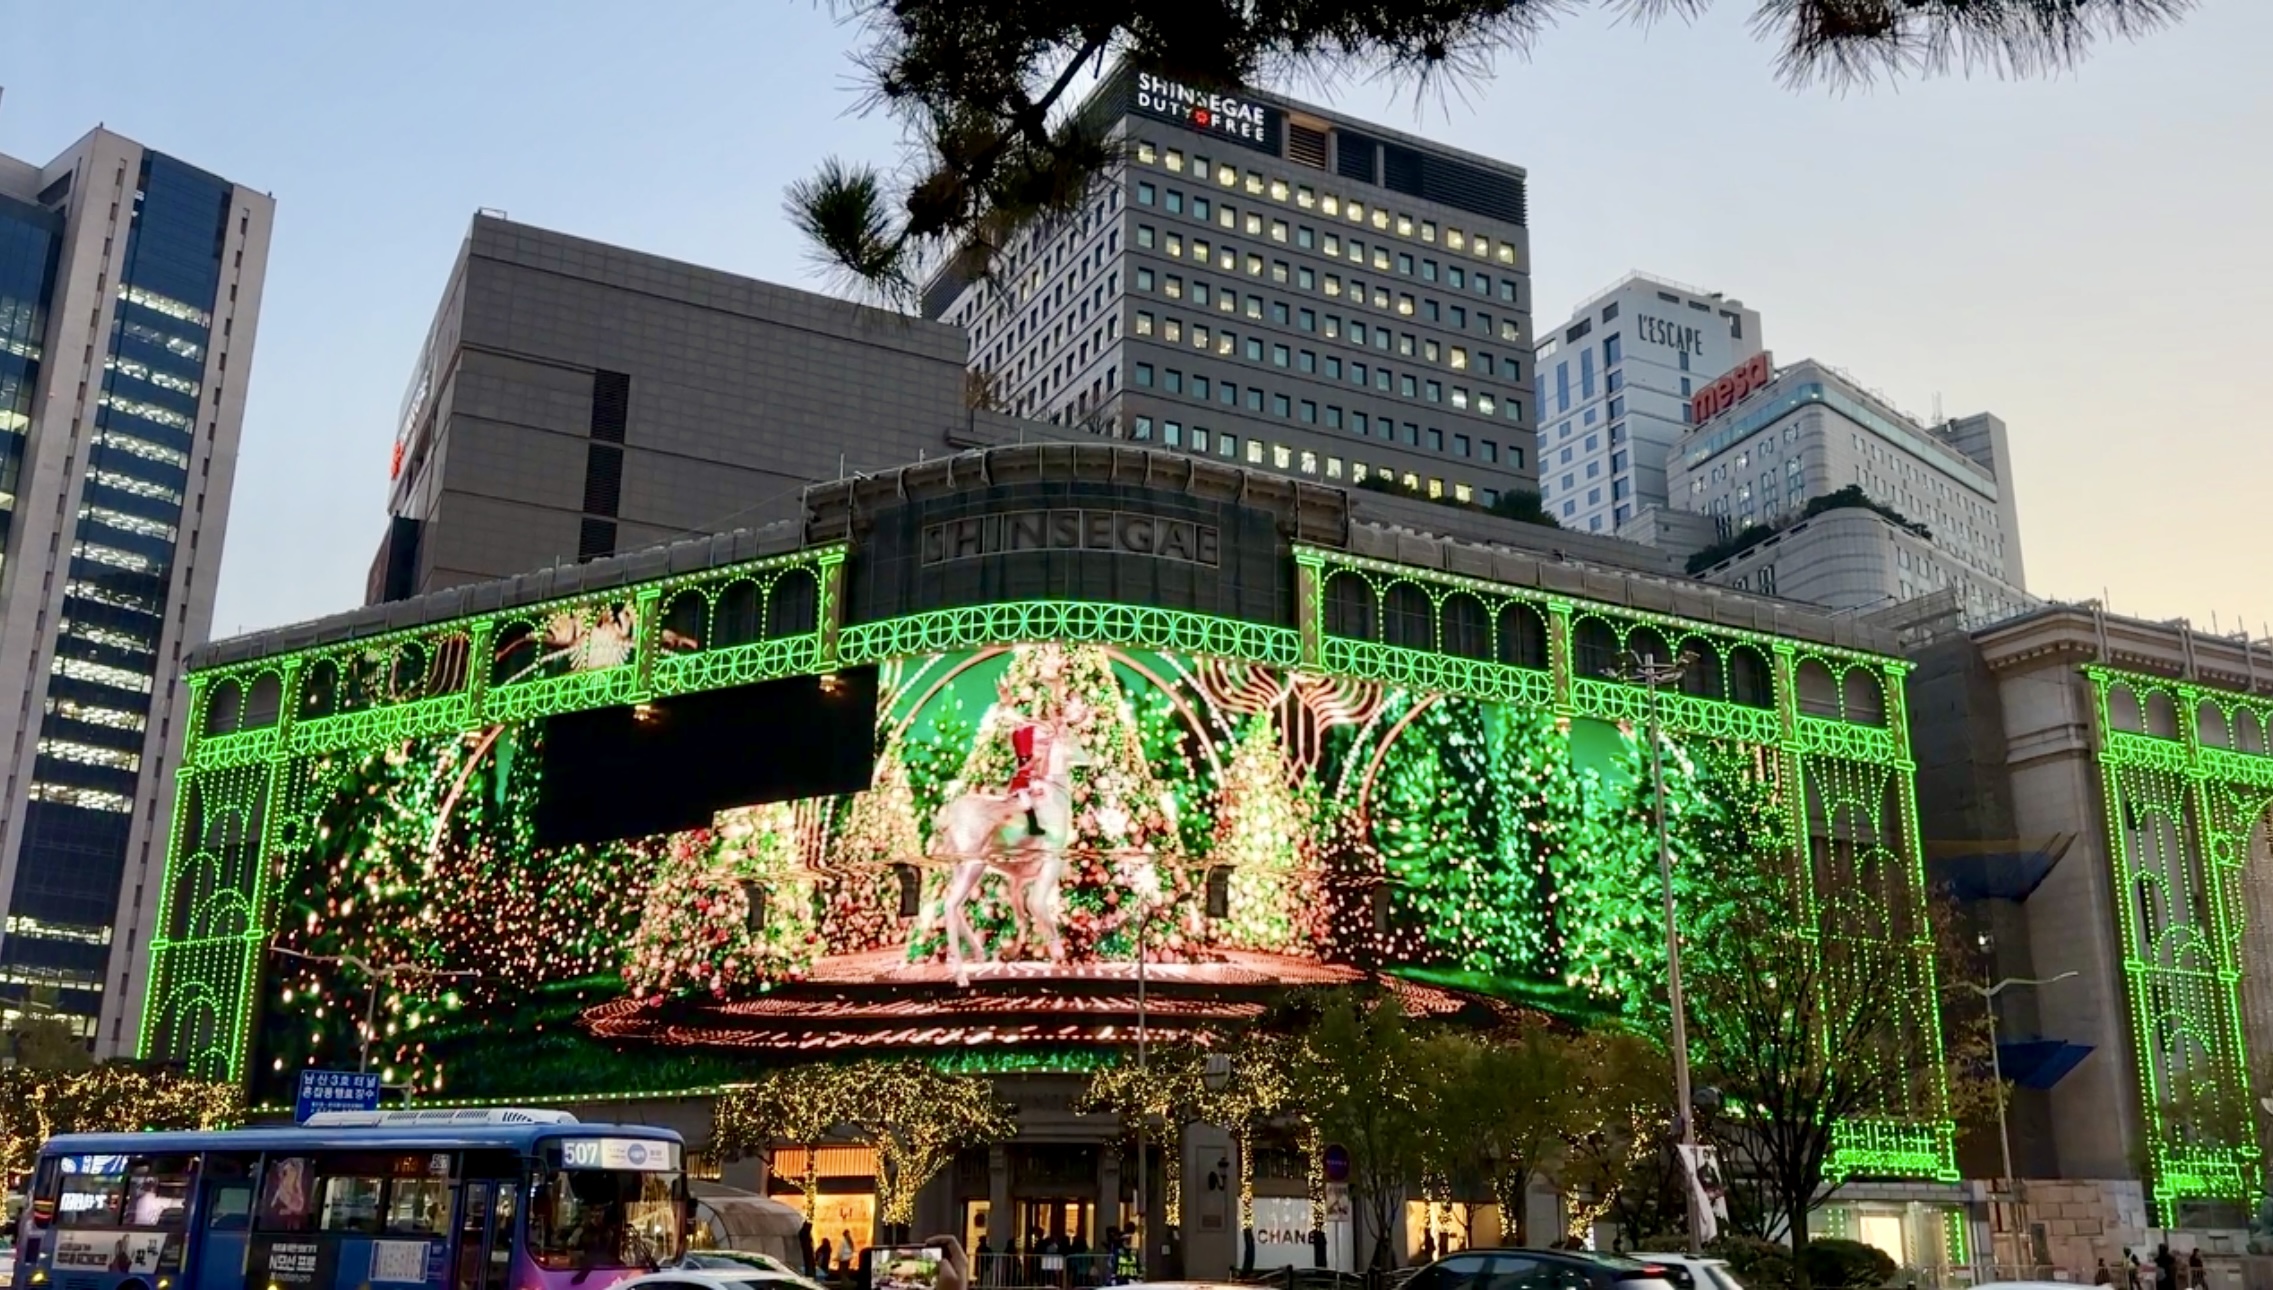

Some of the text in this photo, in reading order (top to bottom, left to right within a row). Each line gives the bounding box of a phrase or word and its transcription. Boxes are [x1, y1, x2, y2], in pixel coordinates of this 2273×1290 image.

[1138, 72, 1265, 126] SHINSEGAE
[1138, 92, 1265, 142] DUTY FREE
[1638, 313, 1703, 355] L'ESCAPE
[1691, 354, 1768, 425] mesa
[924, 511, 1218, 564] SHINSEGAE
[564, 1142, 598, 1164] 507
[1257, 1229, 1316, 1245] CHANE
